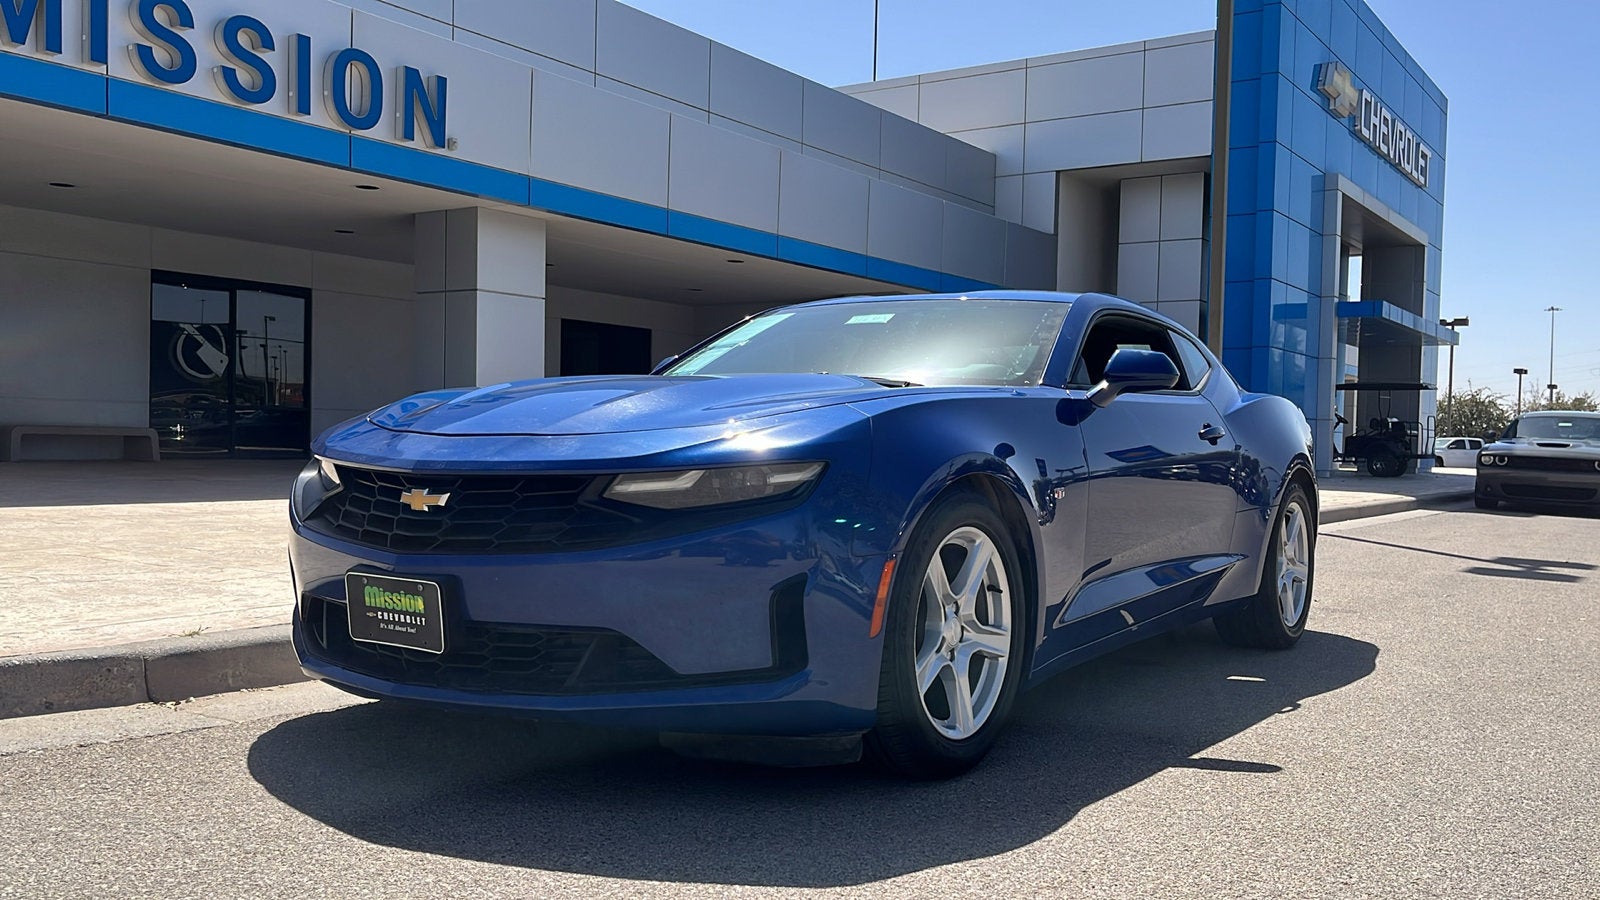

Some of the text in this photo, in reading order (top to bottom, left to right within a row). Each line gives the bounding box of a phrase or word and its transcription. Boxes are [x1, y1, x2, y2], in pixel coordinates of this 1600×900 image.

[1359, 88, 1432, 187] CHEVROLET
[364, 585, 425, 614] Mission
[377, 611, 426, 626] CHEVROLET
